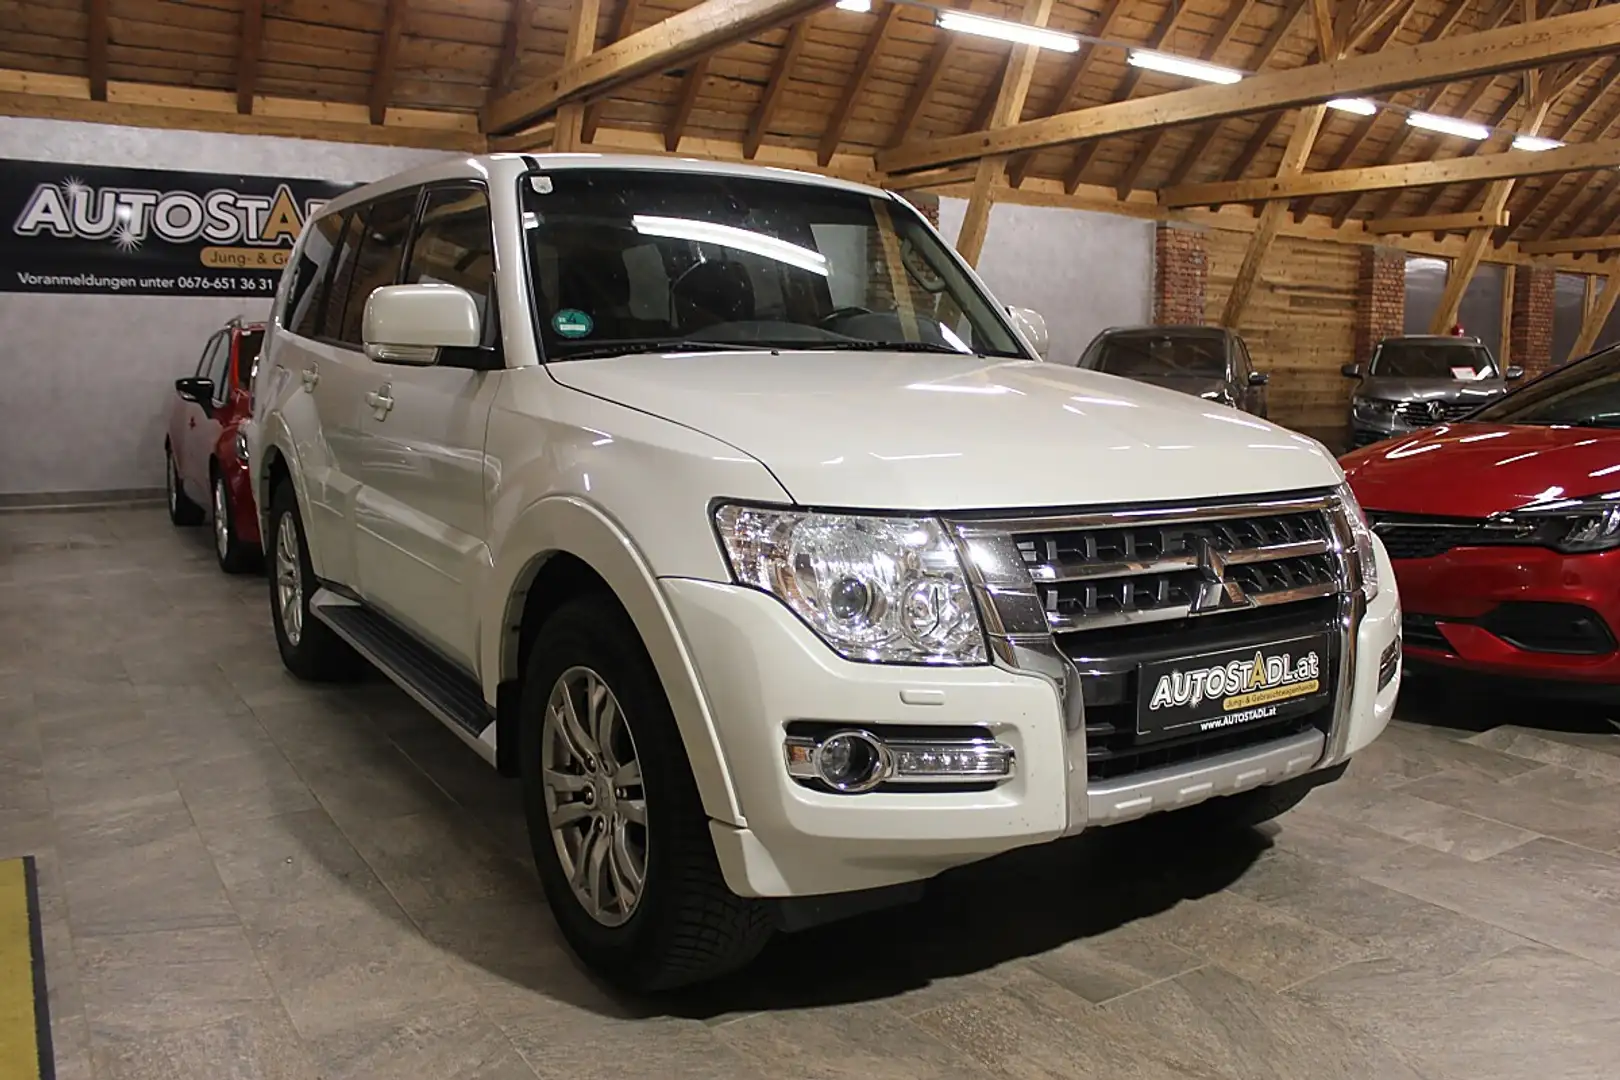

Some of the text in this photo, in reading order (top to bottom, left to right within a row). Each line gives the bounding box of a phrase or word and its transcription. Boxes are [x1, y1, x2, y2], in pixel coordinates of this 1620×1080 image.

[15, 184, 324, 245] AUTOSTA
[210, 251, 251, 268] Jung-
[256, 252, 267, 265] &
[17, 271, 273, 291] Voranmeldungen unter 0676-651 36 31
